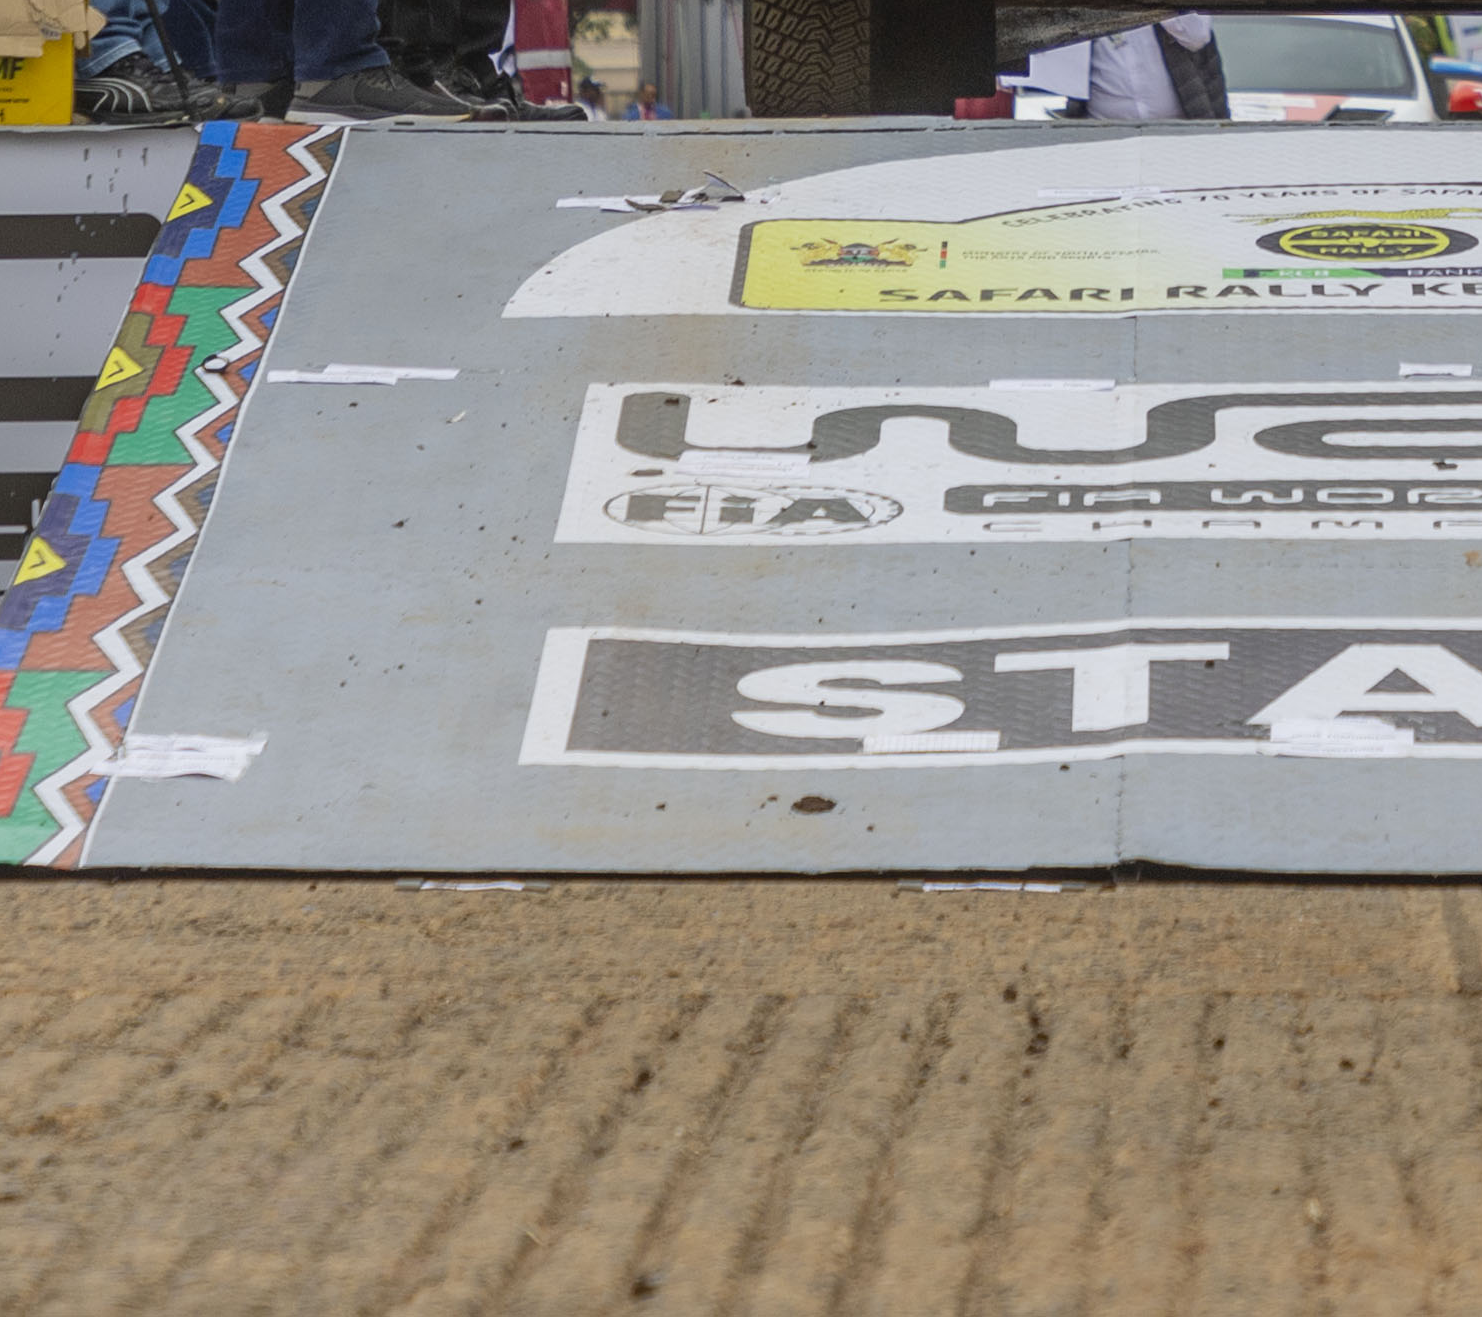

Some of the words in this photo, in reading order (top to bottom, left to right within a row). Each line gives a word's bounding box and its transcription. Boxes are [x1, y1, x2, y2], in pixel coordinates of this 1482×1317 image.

[1002, 195, 1183, 227] CELEBRATING
[1235, 190, 1338, 201] YEARS
[1353, 188, 1386, 197] OF
[1310, 230, 1421, 240] SAFARI
[1320, 247, 1413, 256] RALLY
[879, 286, 1134, 304] SAFARI
[1166, 283, 1383, 300] RALLY
[981, 487, 1161, 509] FIA
